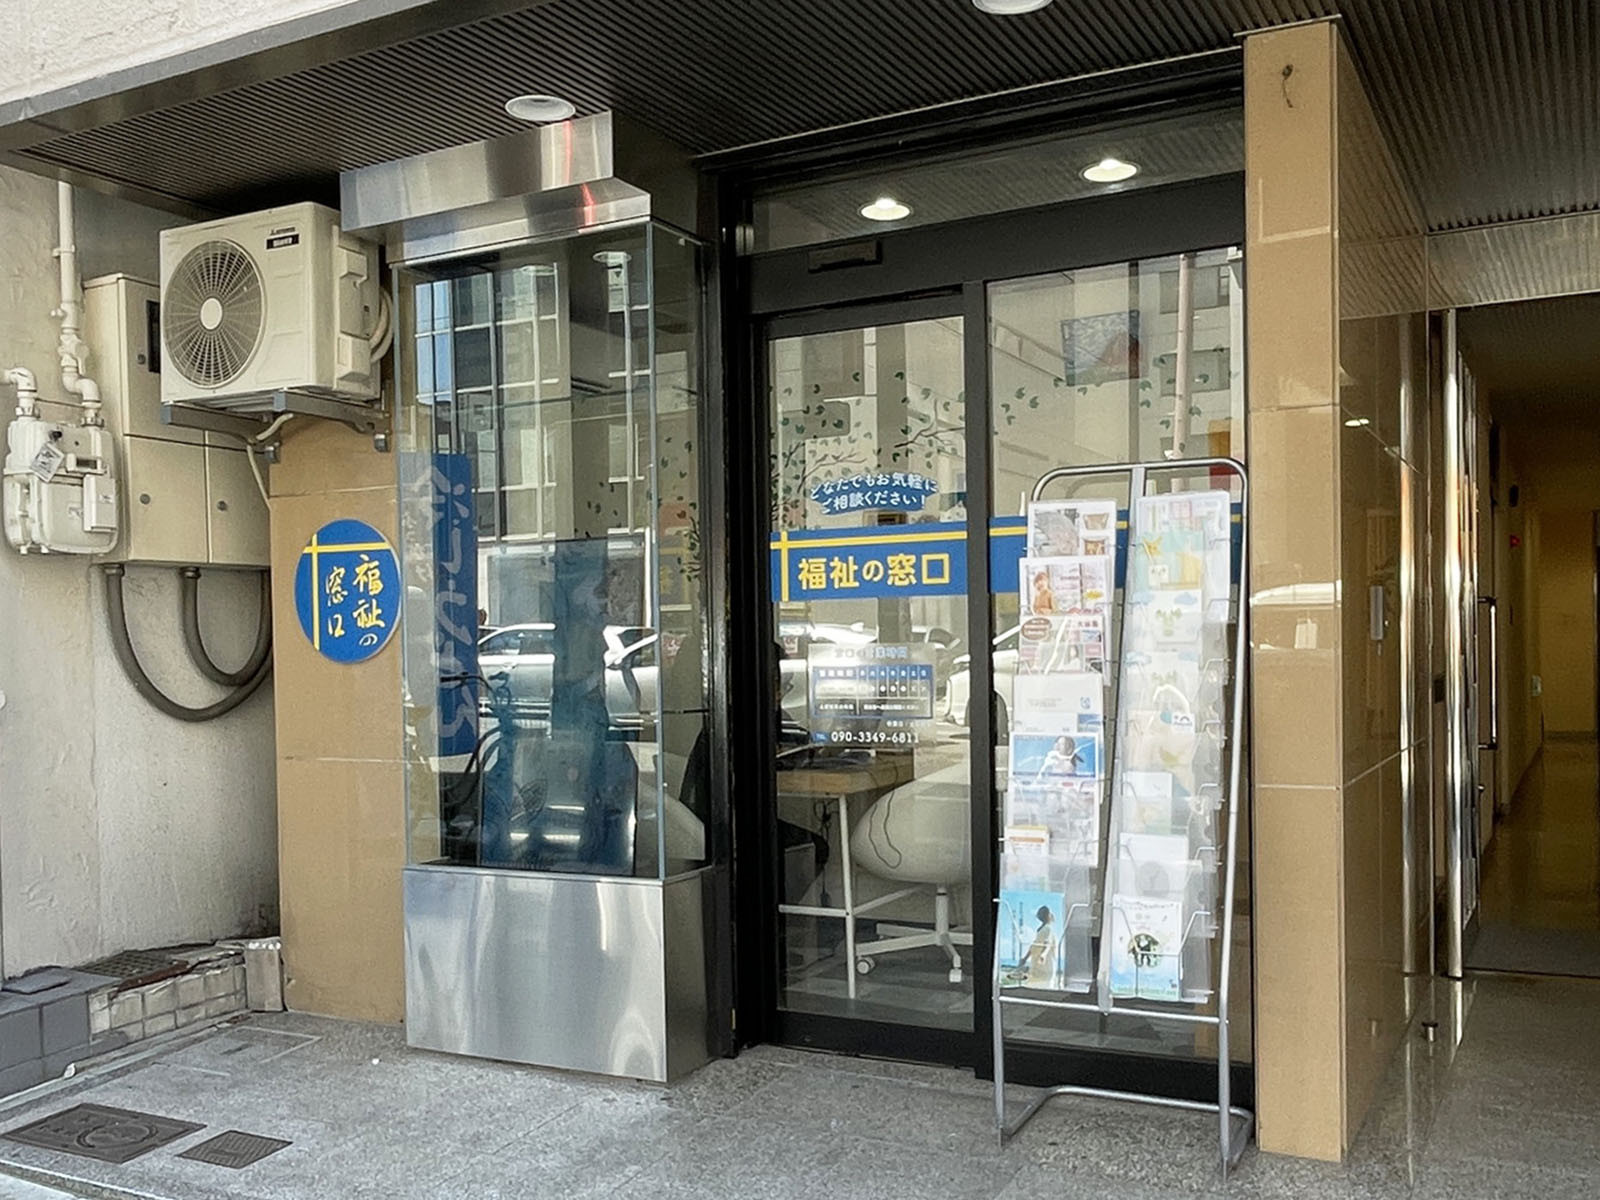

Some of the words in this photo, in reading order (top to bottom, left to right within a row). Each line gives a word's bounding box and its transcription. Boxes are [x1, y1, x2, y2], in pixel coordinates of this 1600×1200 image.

[810, 472, 938, 500] どなたでもお気軽に
[798, 553, 950, 590] 福祉の窓口
[352, 554, 386, 646] 福祉の
